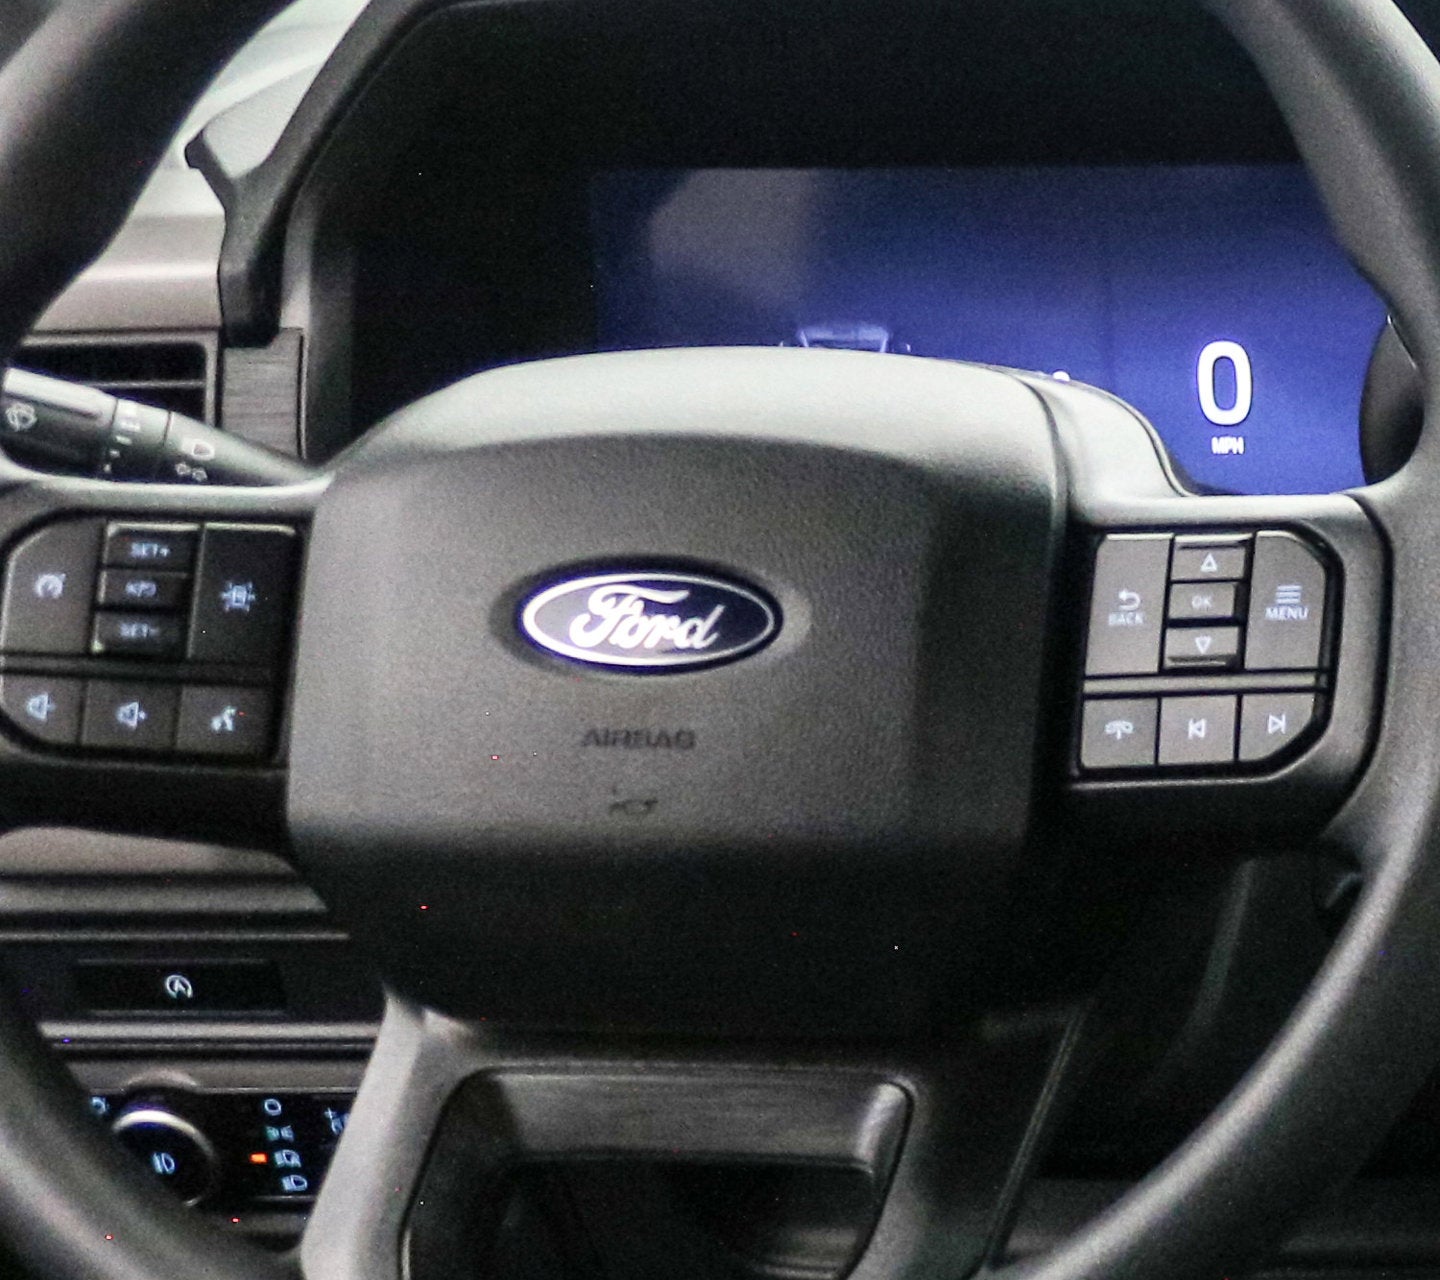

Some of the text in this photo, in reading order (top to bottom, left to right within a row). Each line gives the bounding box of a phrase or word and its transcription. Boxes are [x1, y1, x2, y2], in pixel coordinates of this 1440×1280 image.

[1196, 341, 1254, 426] 0
[1211, 436, 1245, 455] MPH
[568, 584, 727, 650] Ford
[1265, 605, 1309, 621] MENU
